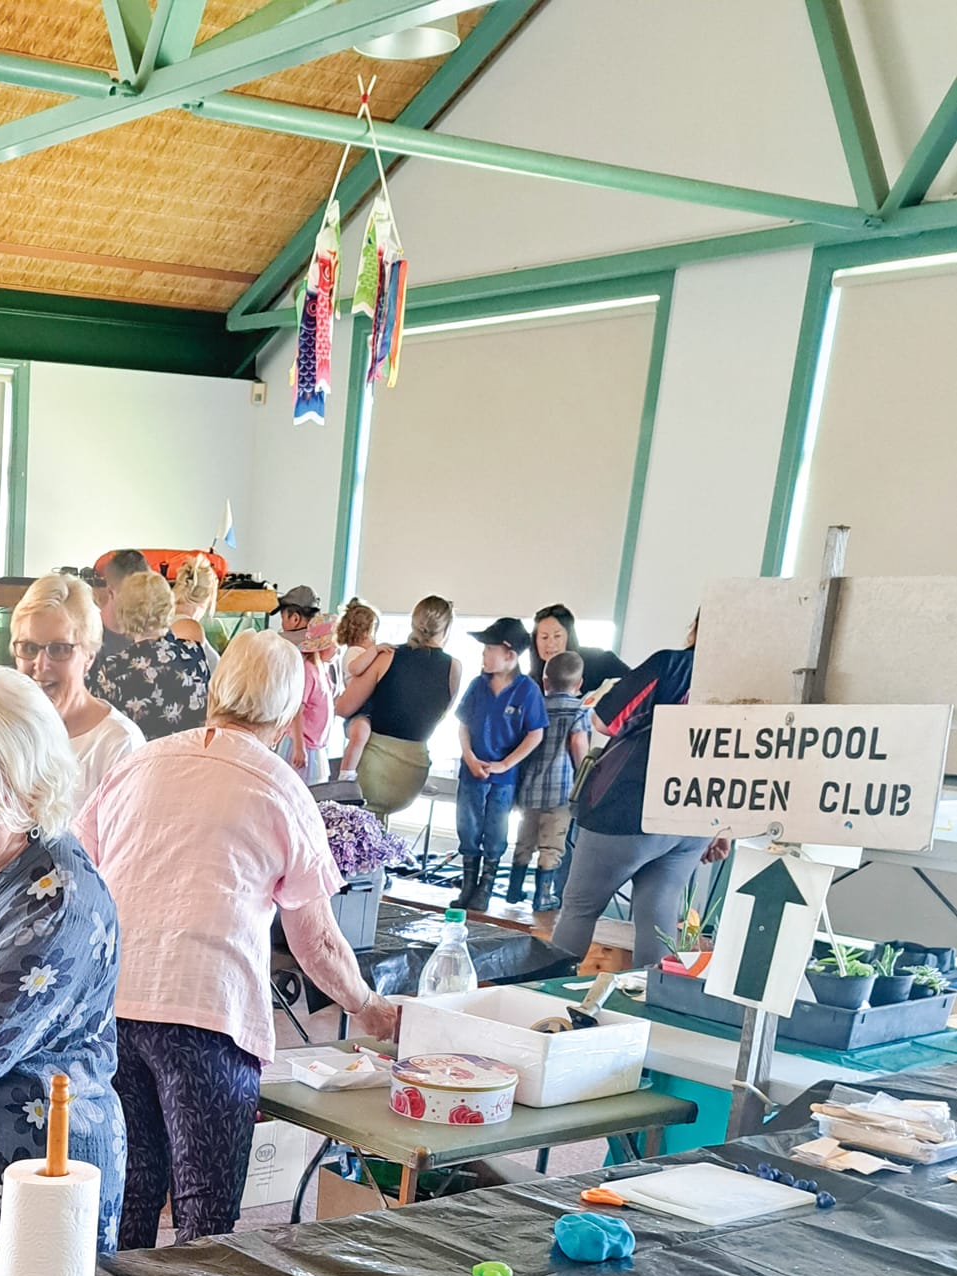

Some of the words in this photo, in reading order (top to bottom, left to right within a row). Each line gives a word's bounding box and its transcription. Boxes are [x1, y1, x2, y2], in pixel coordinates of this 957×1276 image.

[689, 726, 888, 760] WELSHPOOL
[663, 776, 791, 812] GARDEN
[818, 780, 911, 817] CLUB
